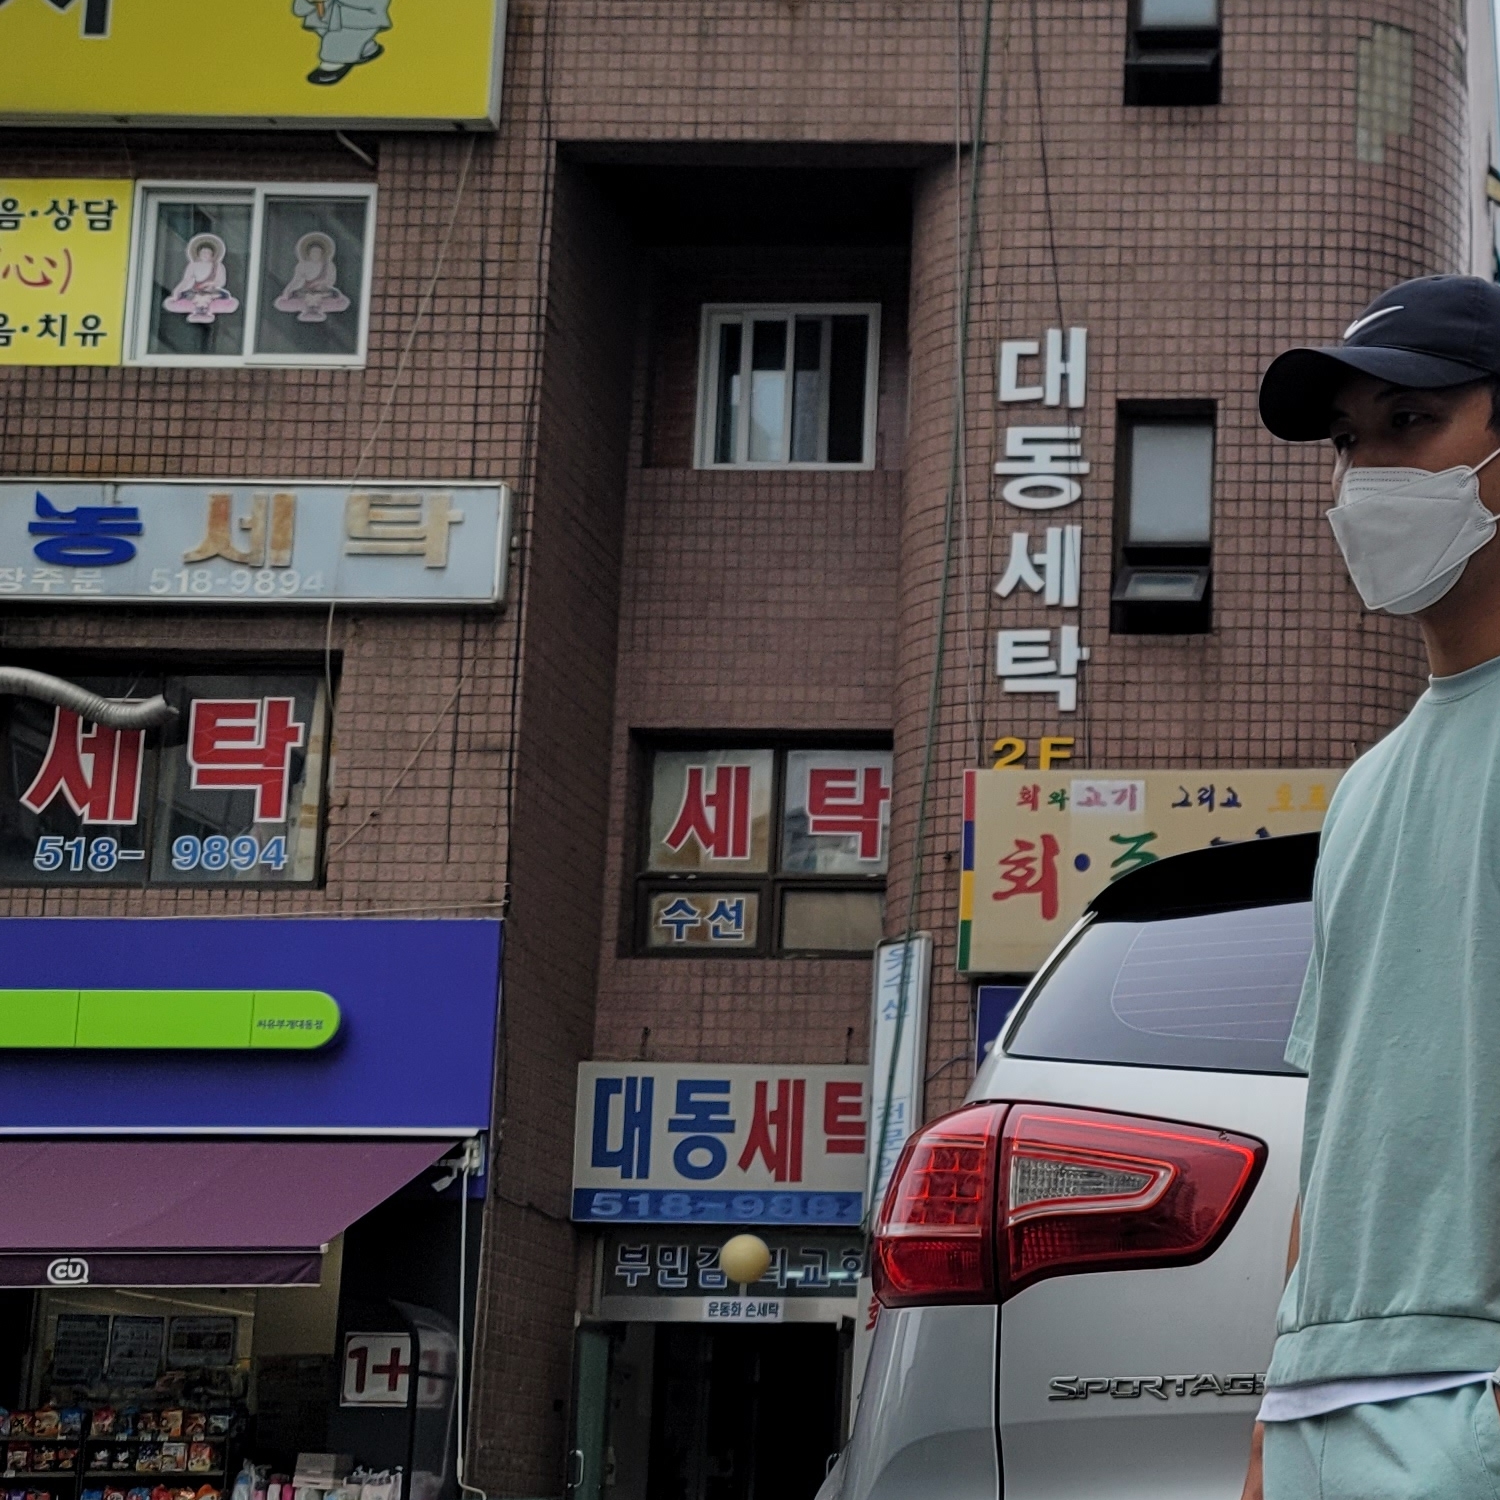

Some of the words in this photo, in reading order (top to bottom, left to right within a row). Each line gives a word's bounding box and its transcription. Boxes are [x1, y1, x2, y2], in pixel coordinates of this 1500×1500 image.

[994, 326, 1090, 712] 대동세탁
[149, 568, 325, 595] 518-9894
[992, 736, 1075, 770] 2F
[1076, 783, 1138, 812] 고기
[1171, 784, 1242, 812] 그리고
[659, 897, 745, 942] 수선
[708, 1302, 742, 1318] 운동화
[745, 1302, 779, 1318] 손세탁
